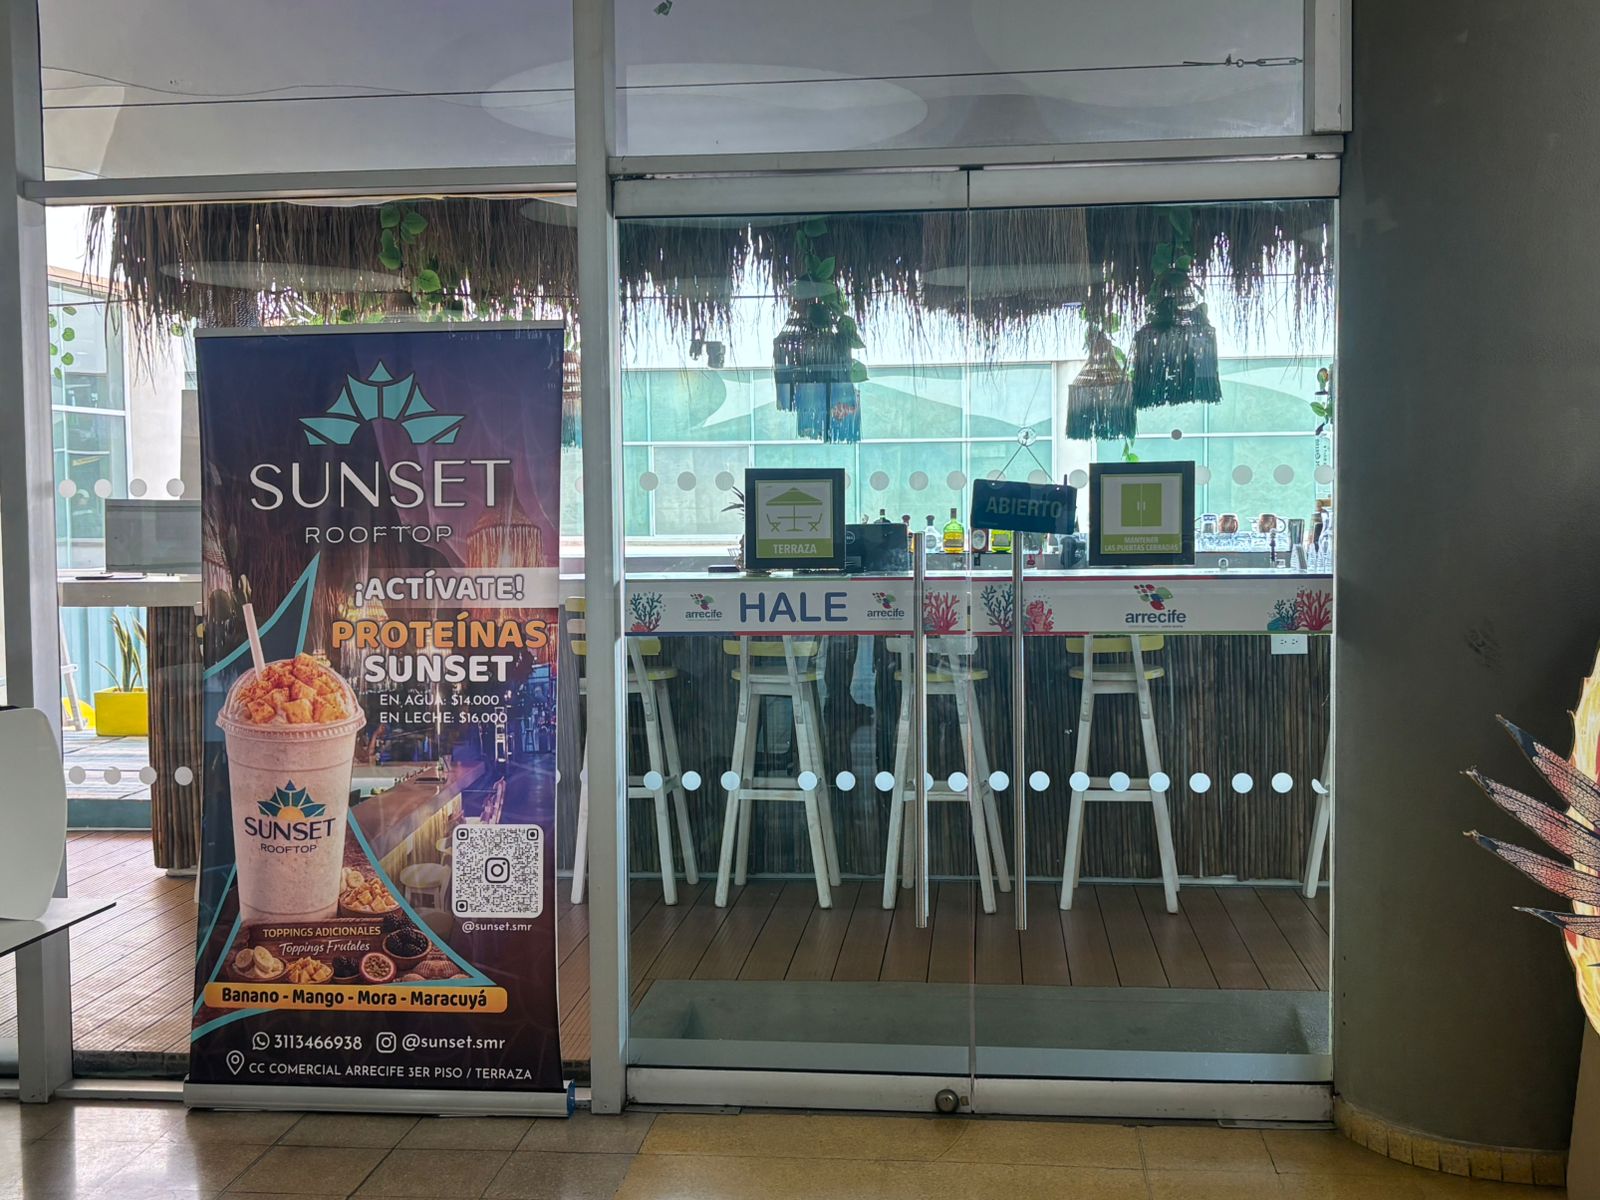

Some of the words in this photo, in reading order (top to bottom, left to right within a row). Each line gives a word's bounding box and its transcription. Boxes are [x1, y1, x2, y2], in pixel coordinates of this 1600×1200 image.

[250, 459, 511, 511] SUNSET
[985, 496, 1063, 519] ABIERTO
[305, 525, 453, 544] ROOFTOP
[773, 543, 817, 554] TERRAZA
[355, 569, 525, 607] ¡ACTÍVATE!
[685, 609, 723, 619] arrecife
[739, 592, 848, 623] HALE
[867, 608, 905, 618] arrecife
[1125, 609, 1187, 624] arrecife
[332, 611, 548, 649] PROTEÍNAS
[364, 654, 514, 683] SUNSET
[380, 695, 400, 706] EN
[405, 695, 447, 706] AGUA:
[451, 694, 500, 706] $14.000
[380, 712, 400, 723] EN
[405, 712, 454, 723] LECHE:
[459, 712, 508, 724] $16.000
[244, 816, 336, 841] SUNSET
[260, 843, 317, 854] ROOFTOP
[262, 928, 313, 938] TOPPINGS
[315, 926, 381, 937] ADICIONALES
[462, 921, 532, 933] @sunset.smr
[278, 942, 325, 956] Toppings
[326, 939, 371, 953] Frutales
[222, 987, 280, 1003] Banano
[292, 989, 344, 1008] Mango
[358, 990, 398, 1006] Mora
[410, 989, 488, 1010] Maracuyá
[274, 1034, 363, 1051] 3113466938
[401, 1033, 506, 1051] @sunset.smr
[249, 1063, 266, 1074] CC
[269, 1064, 342, 1077] COMERCIAL
[345, 1065, 404, 1078] ARRECIFE
[408, 1067, 430, 1078] 3ER
[434, 1067, 463, 1079] PISO
[466, 1067, 473, 1080] /
[476, 1067, 533, 1080] TERRAZA
